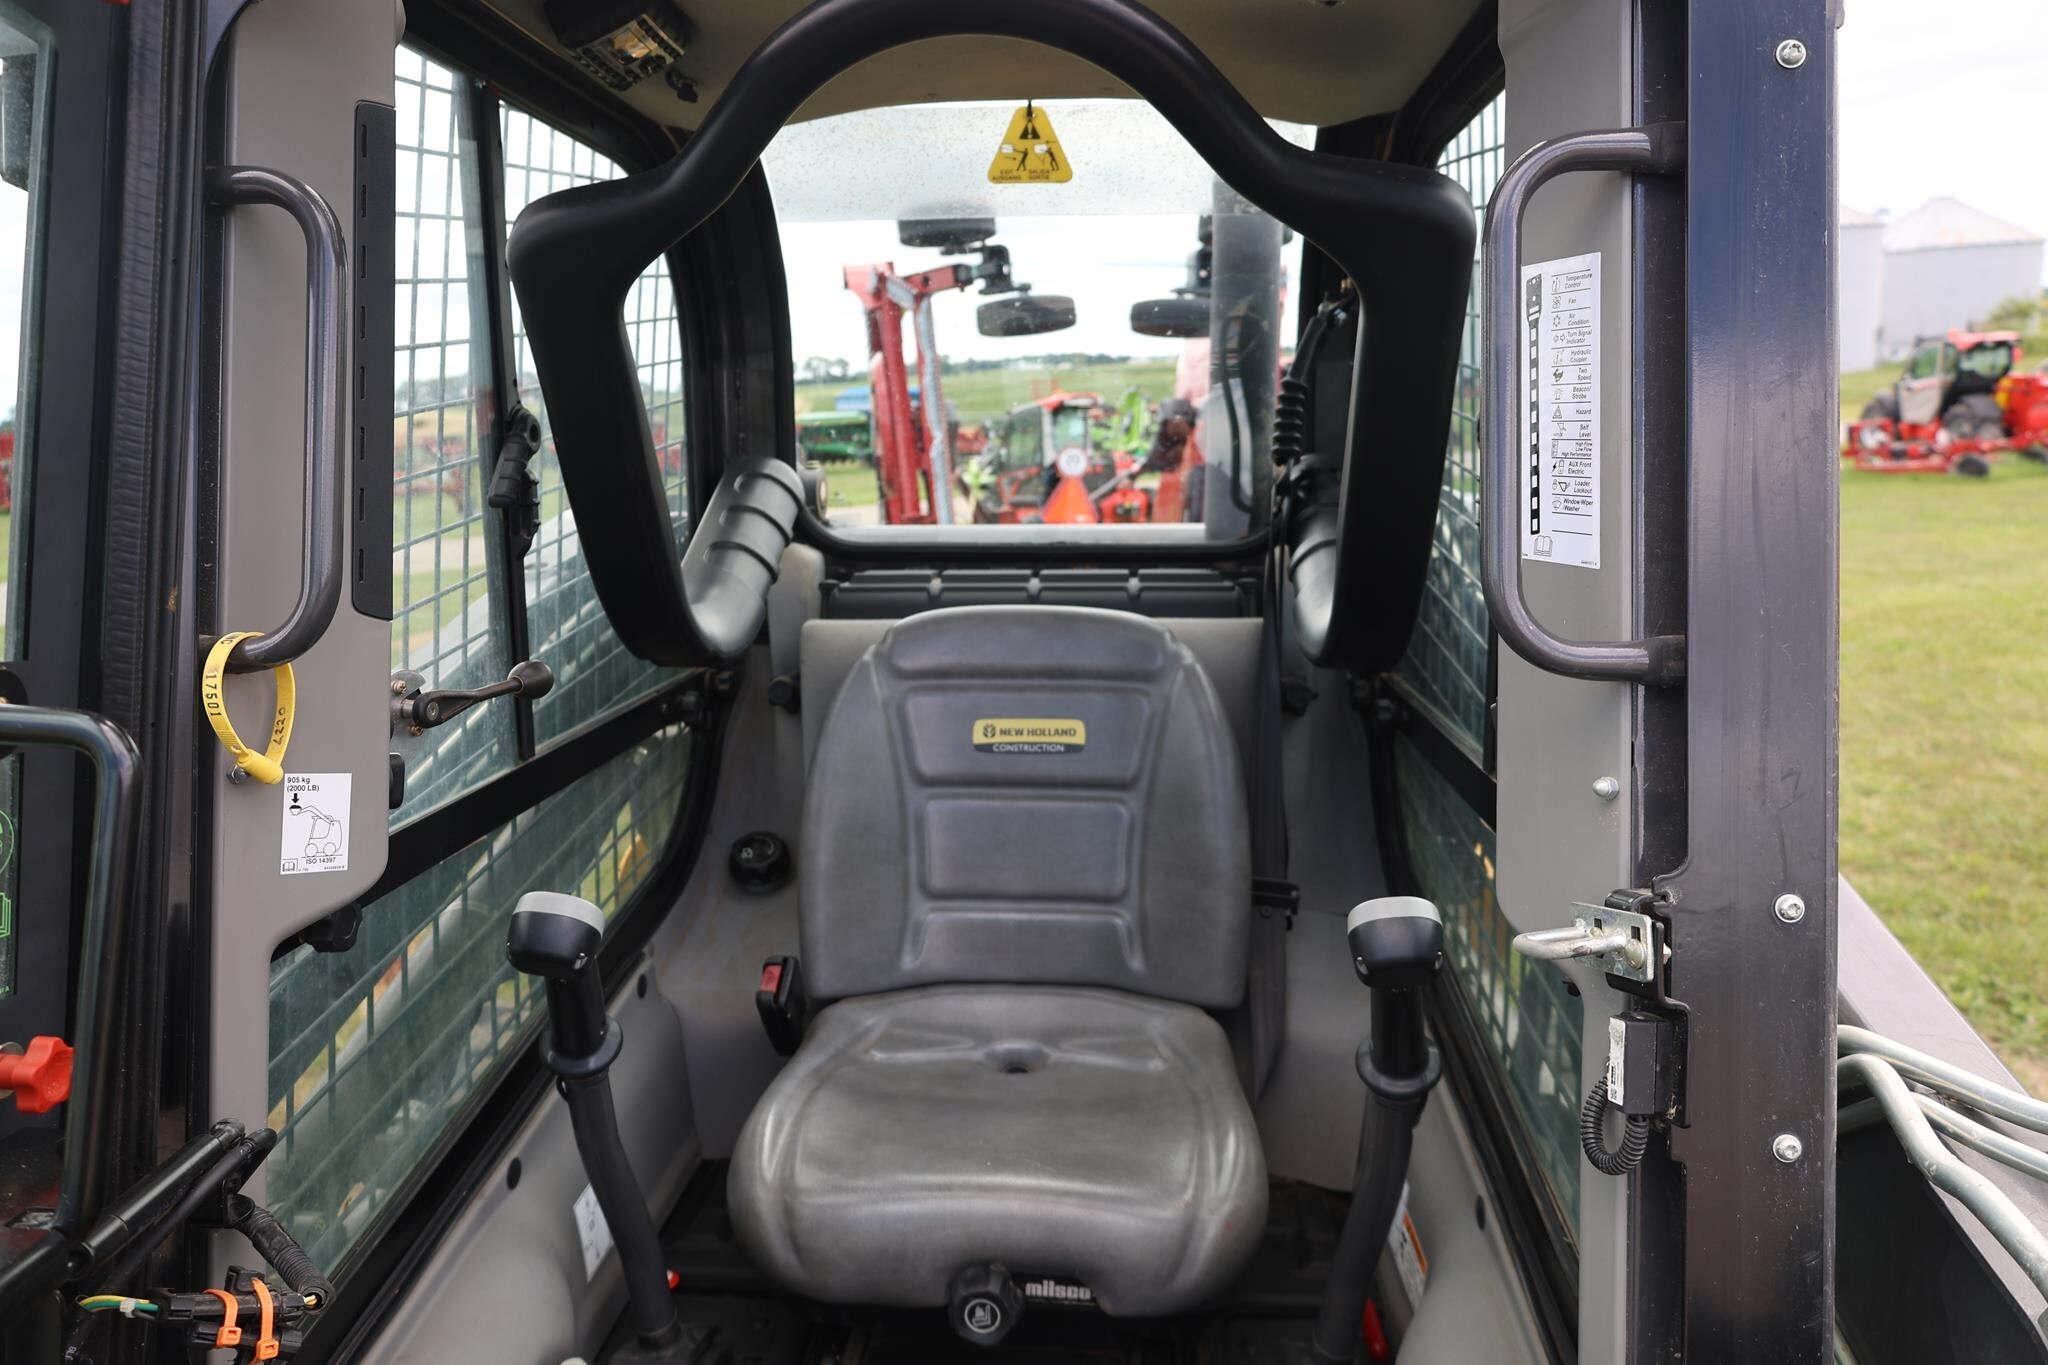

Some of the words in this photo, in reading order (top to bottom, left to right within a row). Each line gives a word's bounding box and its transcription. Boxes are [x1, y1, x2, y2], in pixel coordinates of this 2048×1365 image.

[1566, 273, 1592, 281] Temperature
[1565, 281, 1581, 289] Control
[205, 673, 222, 718] 17501
[1000, 728, 1024, 736] NEW
[1027, 728, 1076, 737] HOLLAND
[992, 744, 1064, 752] CONSTRUCTION
[302, 777, 310, 785] kg
[307, 784, 319, 792] LB)
[1026, 1280, 1091, 1299] milsco
